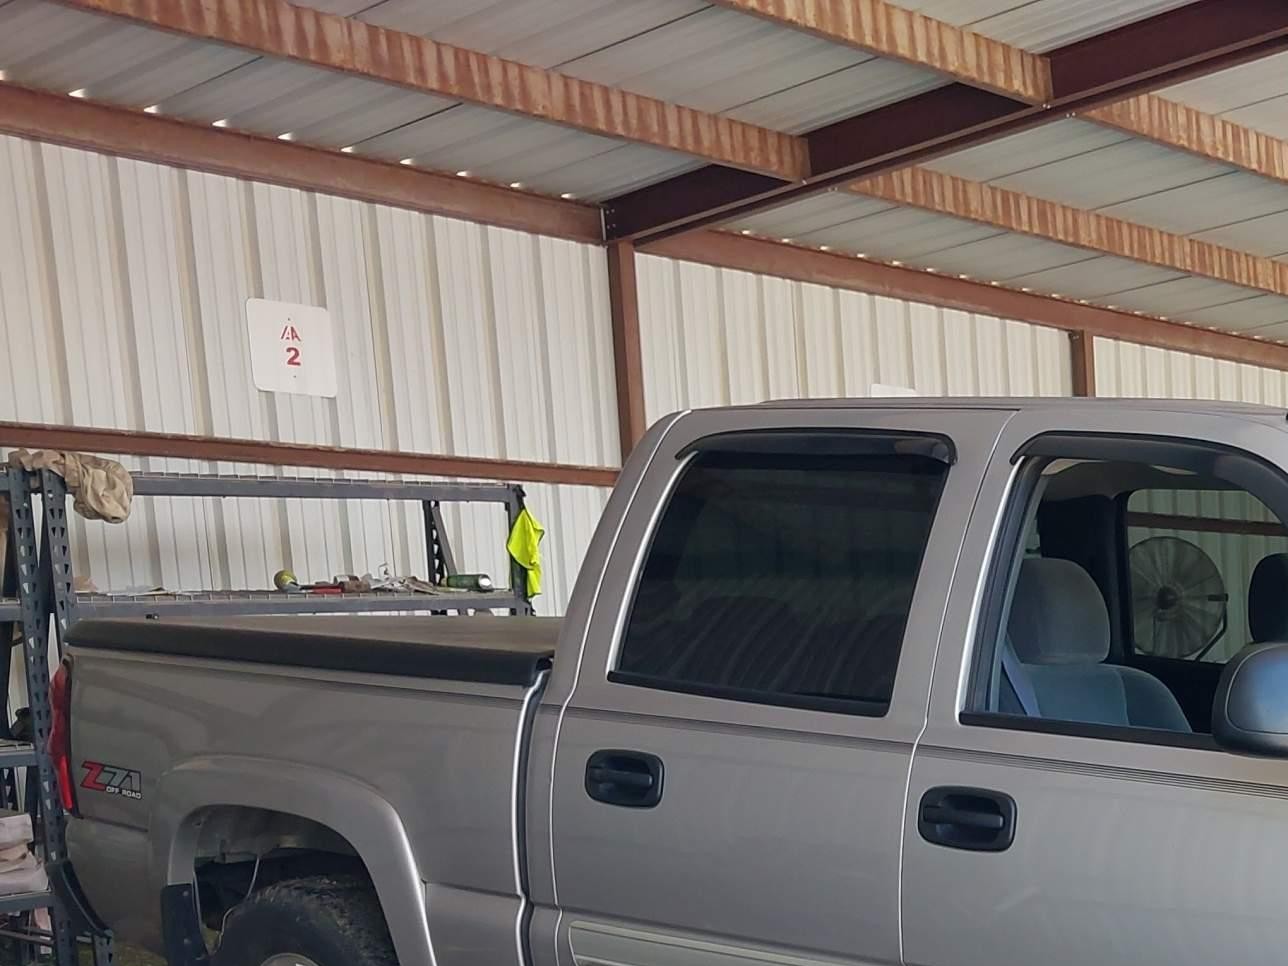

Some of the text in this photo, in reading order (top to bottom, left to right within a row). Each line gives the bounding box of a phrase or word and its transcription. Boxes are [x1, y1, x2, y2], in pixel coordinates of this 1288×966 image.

[286, 347, 302, 366] 2
[80, 761, 142, 792] Z71
[105, 786, 142, 799] OFF ROAD
